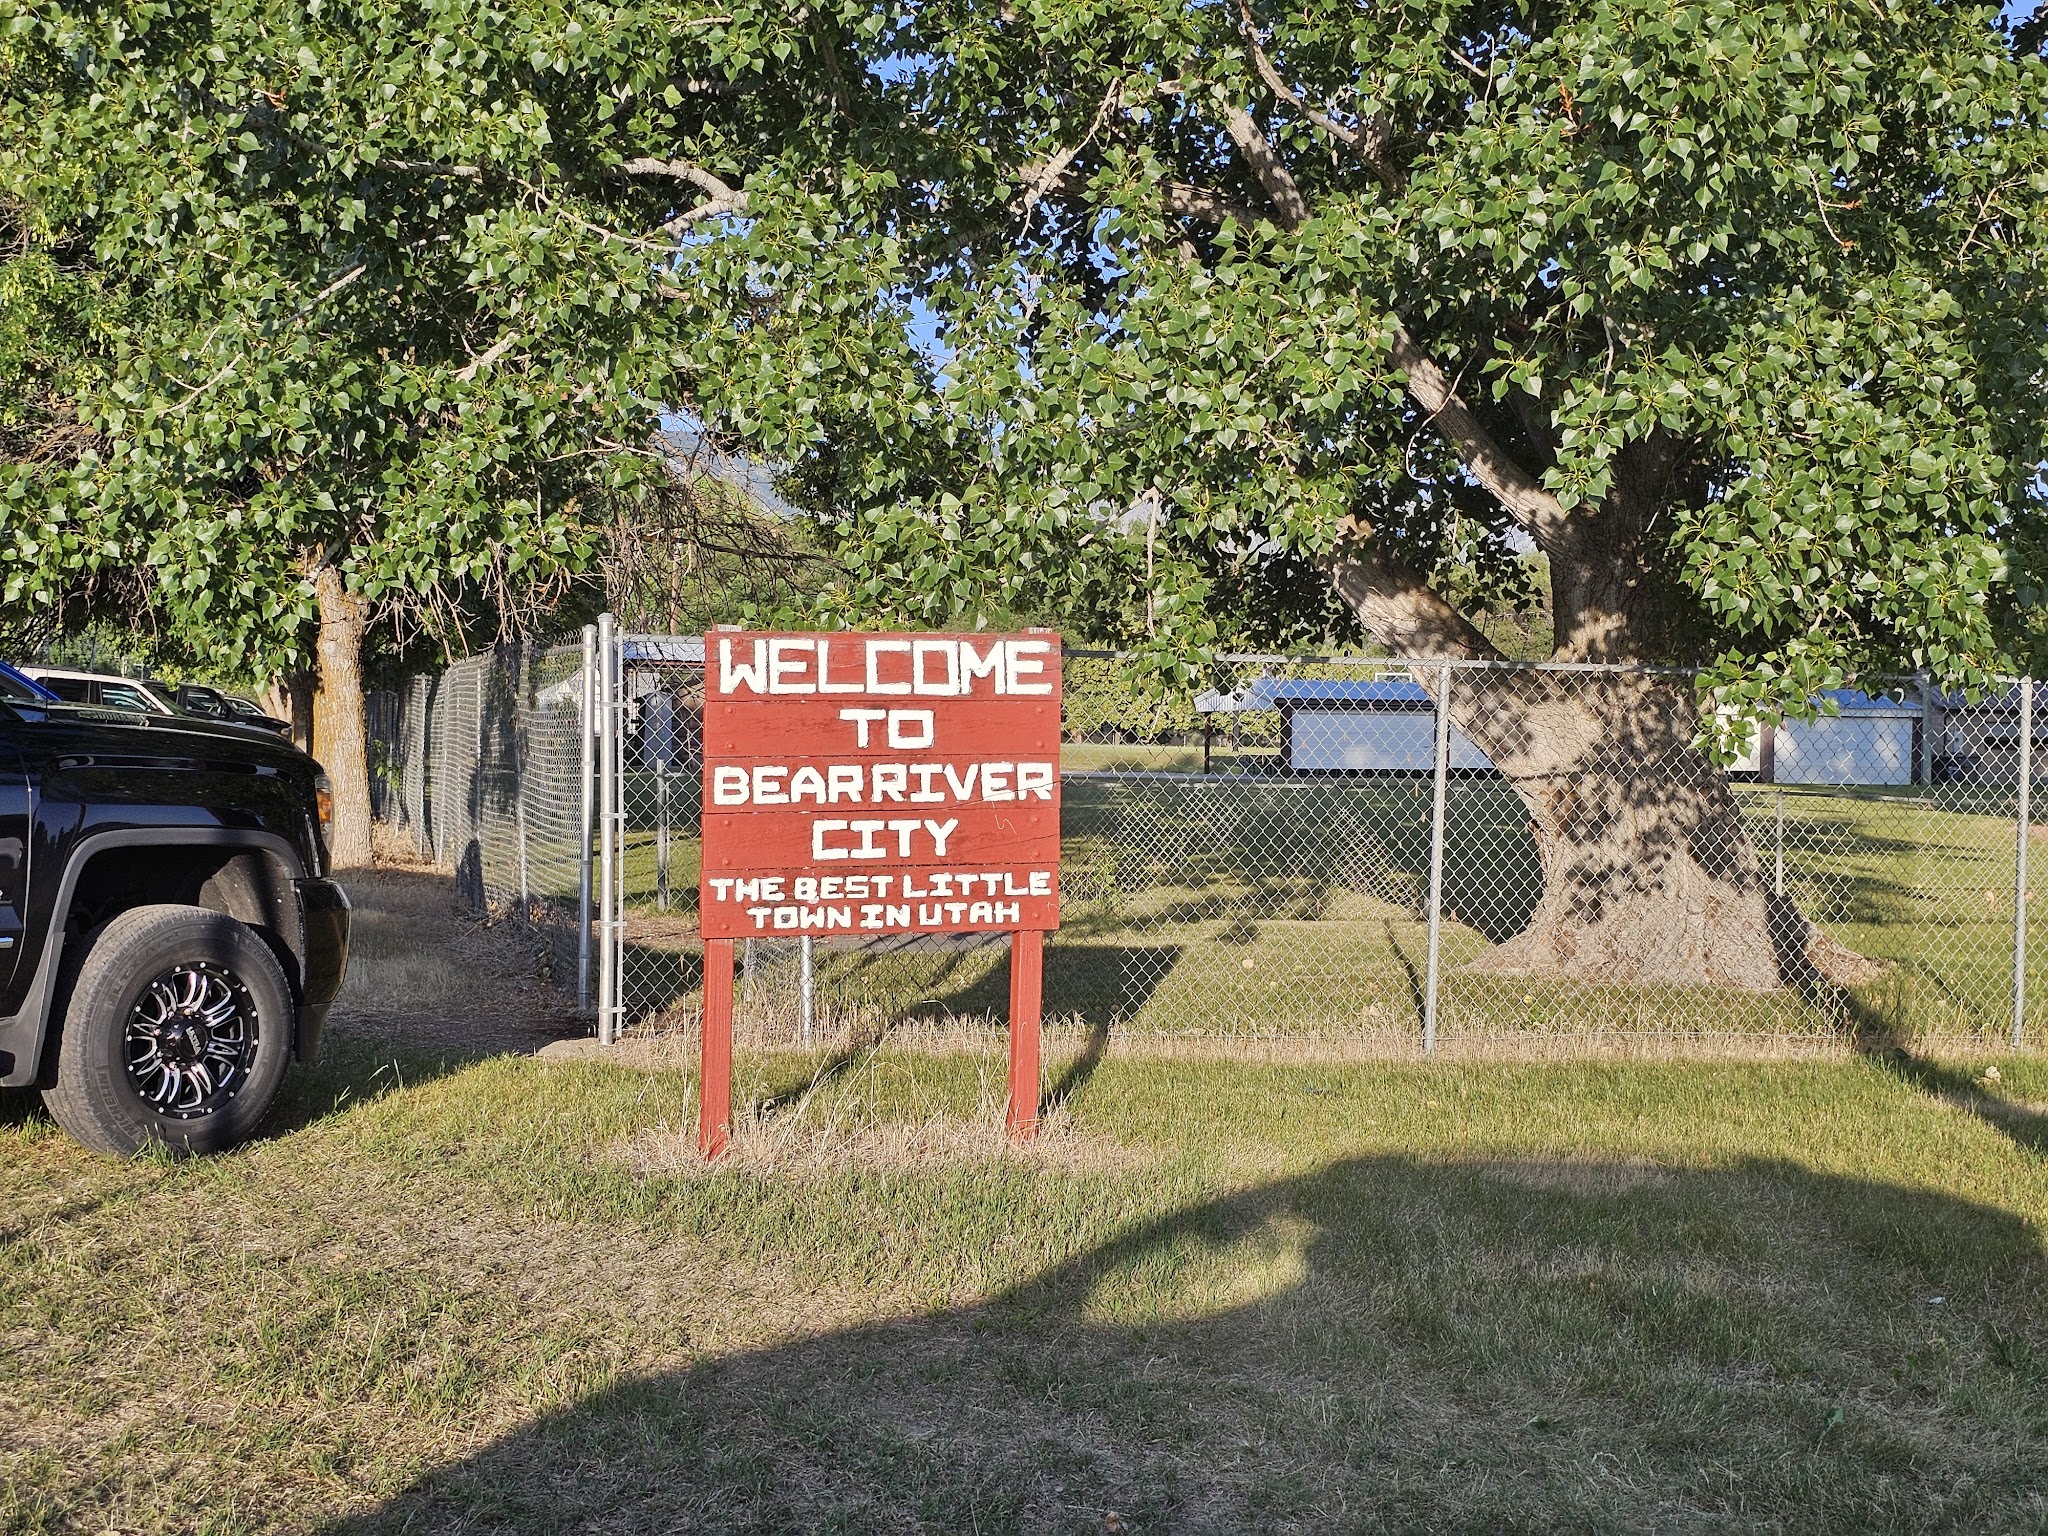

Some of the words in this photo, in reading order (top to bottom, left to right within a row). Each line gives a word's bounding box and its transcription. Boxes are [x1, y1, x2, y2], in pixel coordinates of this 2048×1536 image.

[719, 638, 1053, 696] WELCOME
[839, 708, 934, 749] TO
[713, 765, 863, 805] BEAR
[871, 761, 1053, 803] RIVER
[812, 818, 958, 860] CITY
[709, 876, 785, 902] THE
[794, 875, 893, 904] BEST
[902, 872, 1051, 898] LITTLE
[746, 905, 851, 929] TOWN
[860, 903, 910, 929] IN
[919, 901, 1020, 925] UTAH
[185, 1025, 202, 1055] ULTRA
[97, 1071, 138, 1137] MICHELIN
